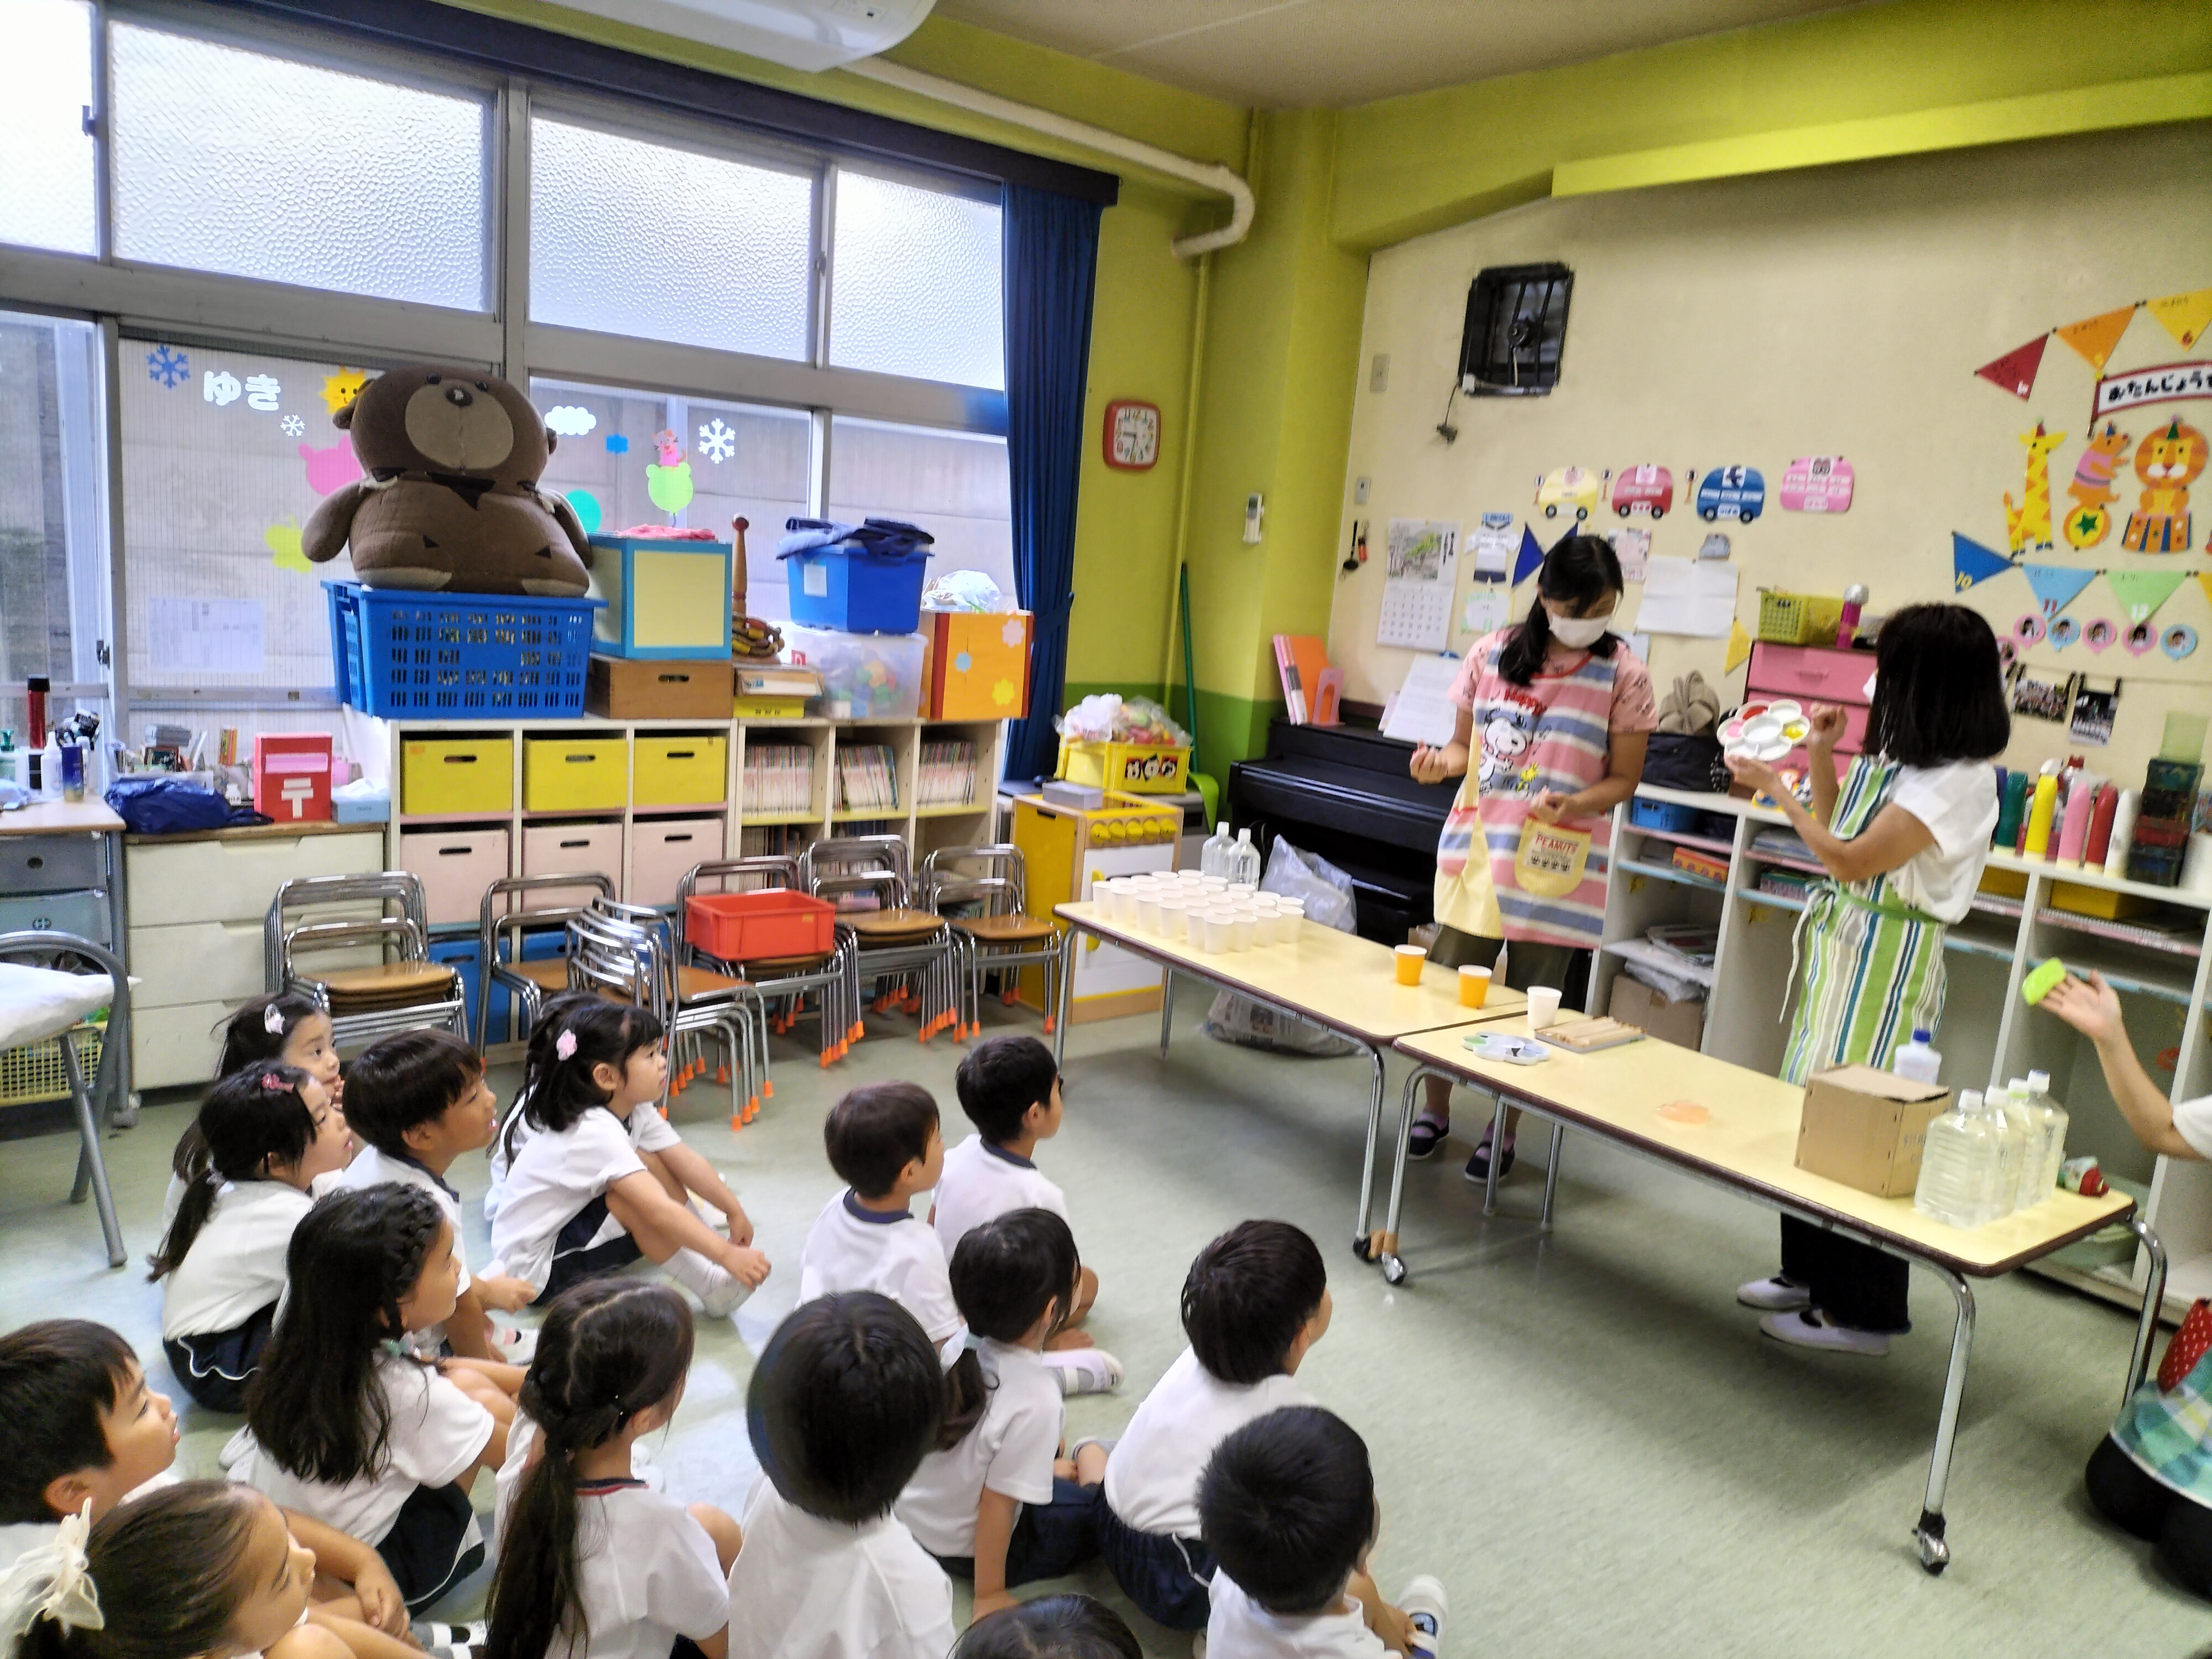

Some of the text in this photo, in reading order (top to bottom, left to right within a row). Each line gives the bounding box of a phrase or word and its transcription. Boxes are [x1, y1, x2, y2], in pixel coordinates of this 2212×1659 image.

[202, 369, 282, 412] ゆき
[1955, 571, 1973, 589] 10
[2042, 598, 2058, 614] 11
[2131, 603, 2150, 620] 12
[1503, 688, 1548, 717] Happy
[1535, 834, 1579, 854] PEANUTS
